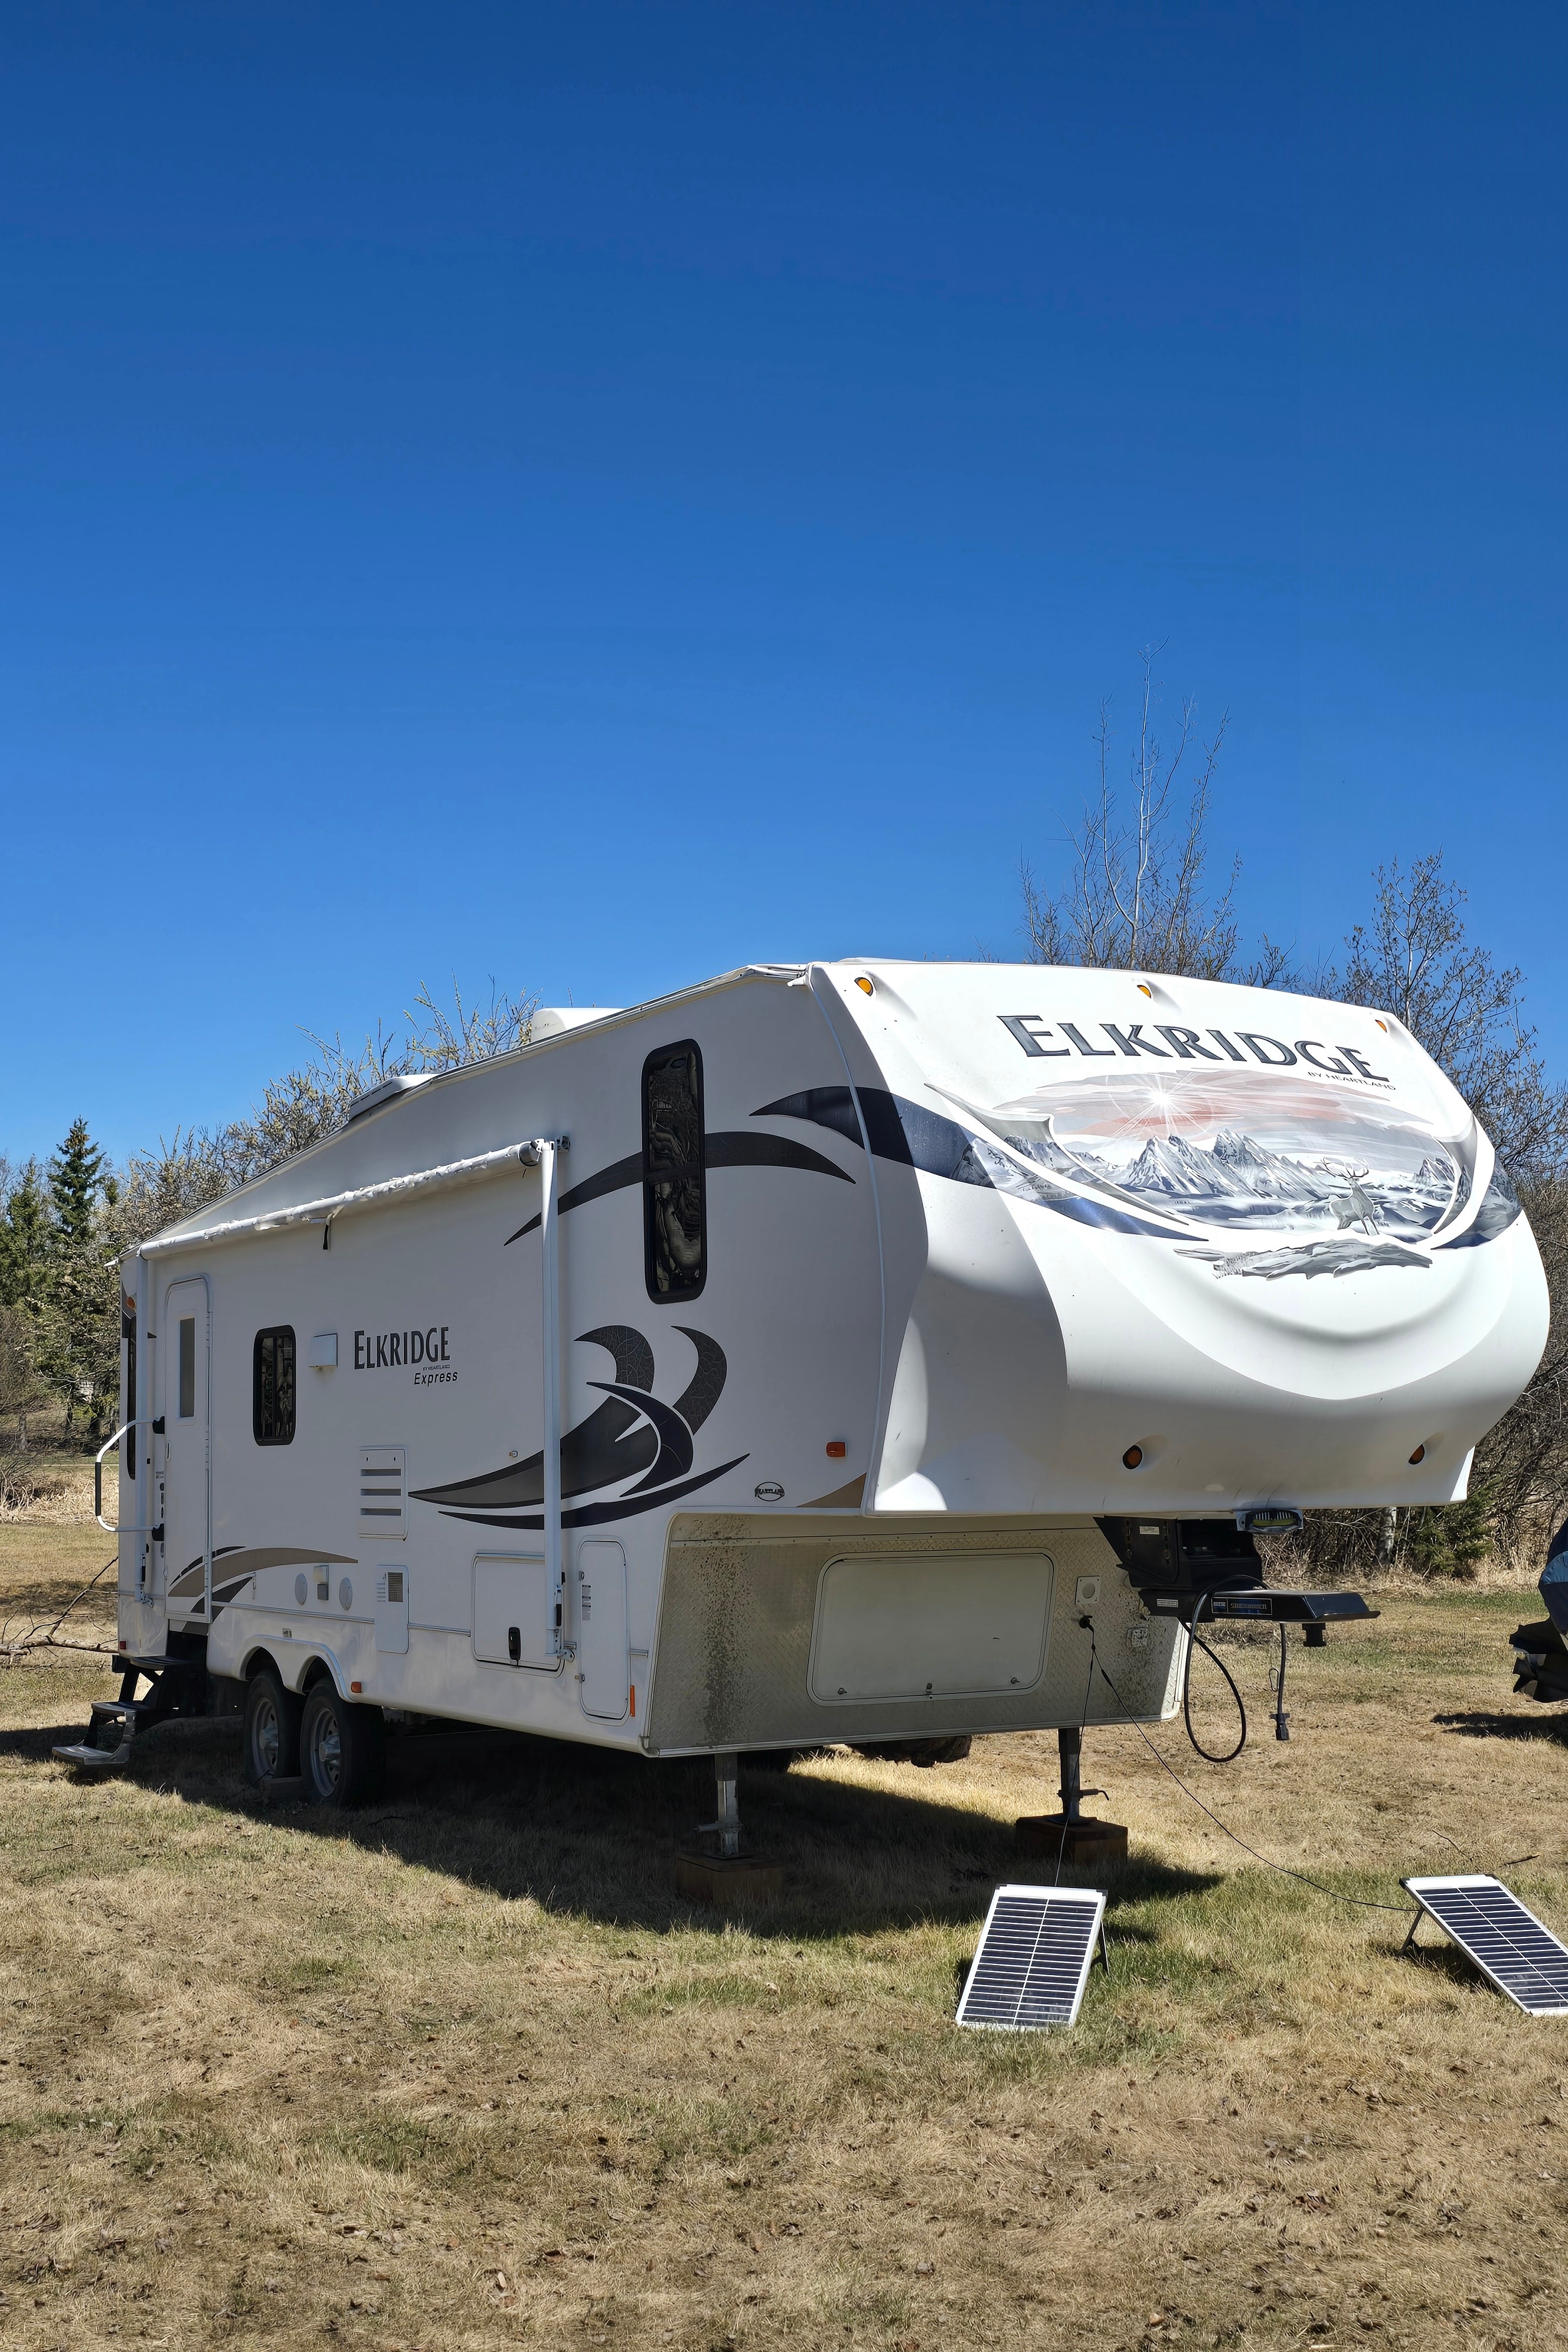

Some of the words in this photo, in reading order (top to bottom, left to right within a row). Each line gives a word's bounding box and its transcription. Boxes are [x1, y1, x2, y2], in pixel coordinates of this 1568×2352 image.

[997, 1015, 1389, 1083] ELKRIDGE
[1325, 1074, 1396, 1090] HEARTLAND
[354, 1327, 450, 1369] ELKRIDGE
[414, 1372, 458, 1387] Express
